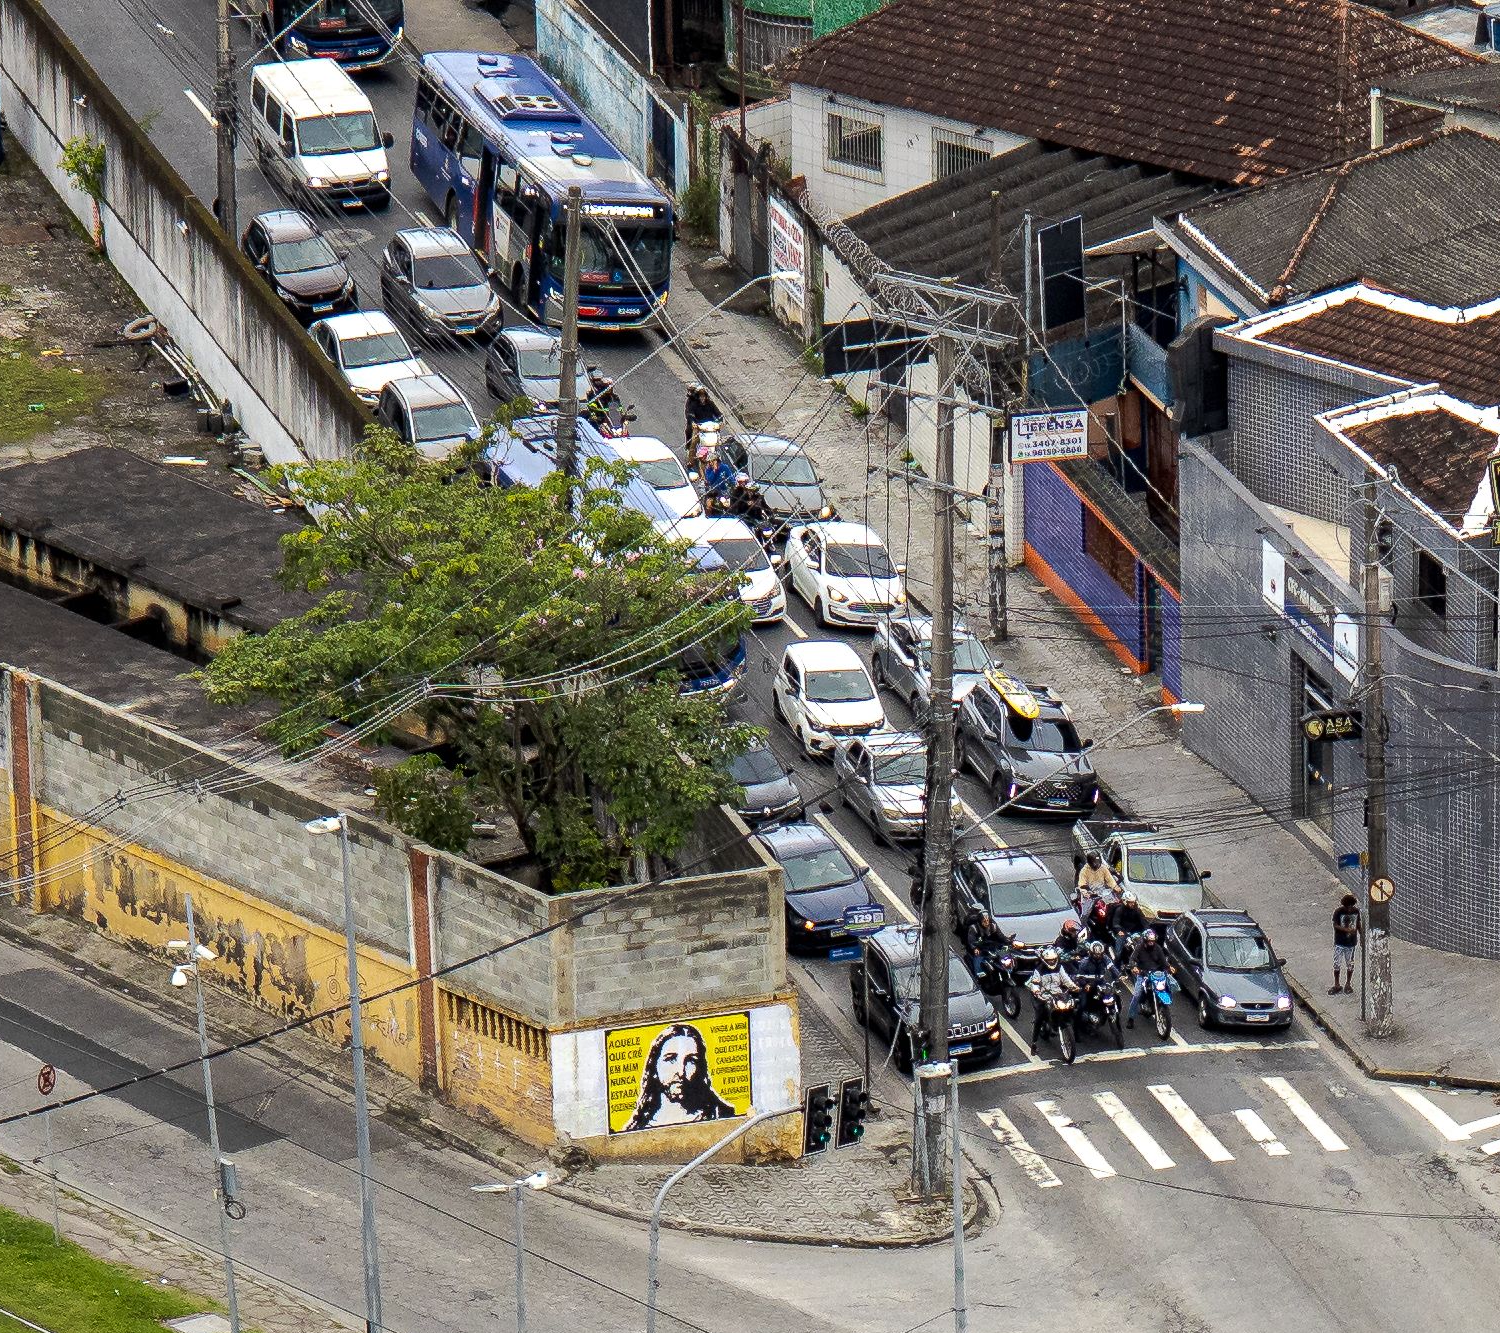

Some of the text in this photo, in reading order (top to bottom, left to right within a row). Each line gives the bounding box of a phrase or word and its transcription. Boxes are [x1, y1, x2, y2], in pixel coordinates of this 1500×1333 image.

[609, 1036, 641, 1049] AQUELE
[609, 1050, 626, 1062] QUE
[609, 1062, 639, 1075] EM MIM
[610, 1075, 637, 1087] NUNCA
